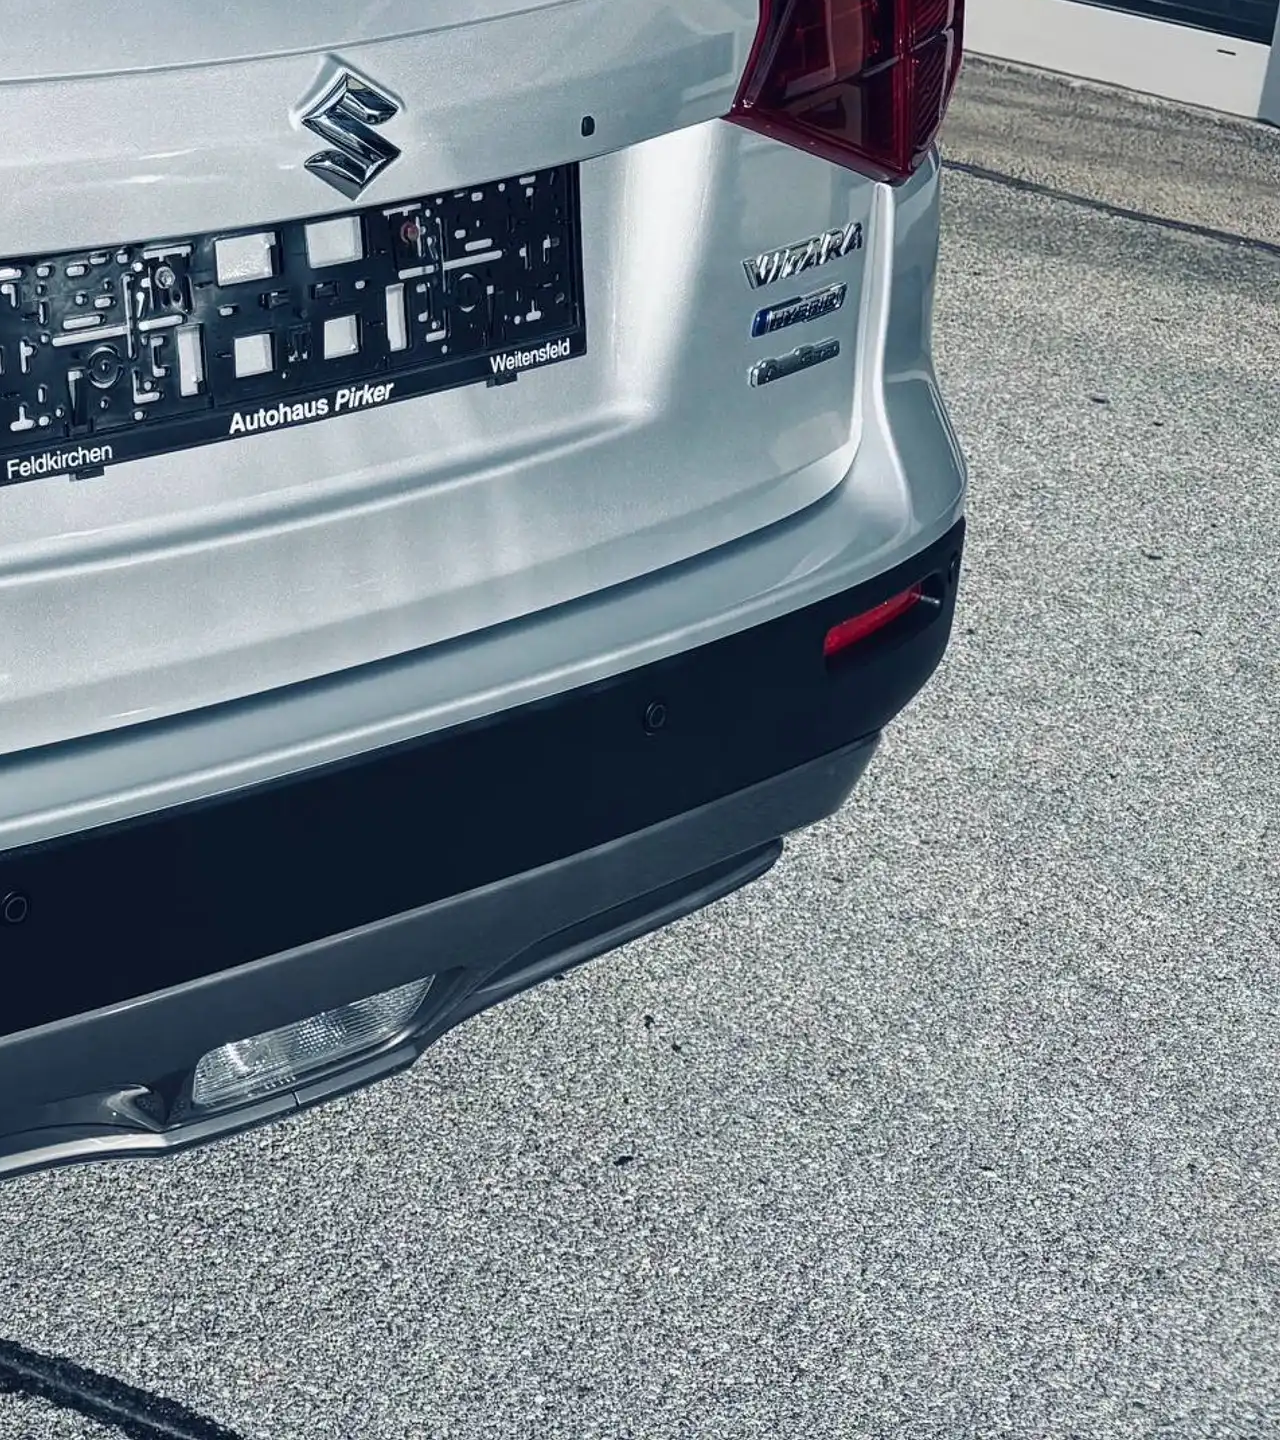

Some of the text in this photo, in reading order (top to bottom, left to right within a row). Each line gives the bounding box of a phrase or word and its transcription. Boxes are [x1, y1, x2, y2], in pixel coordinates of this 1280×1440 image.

[489, 338, 571, 374] Weitensfeld
[228, 380, 394, 435] Autohaus Pirker
[6, 442, 113, 480] Feldkirchen
